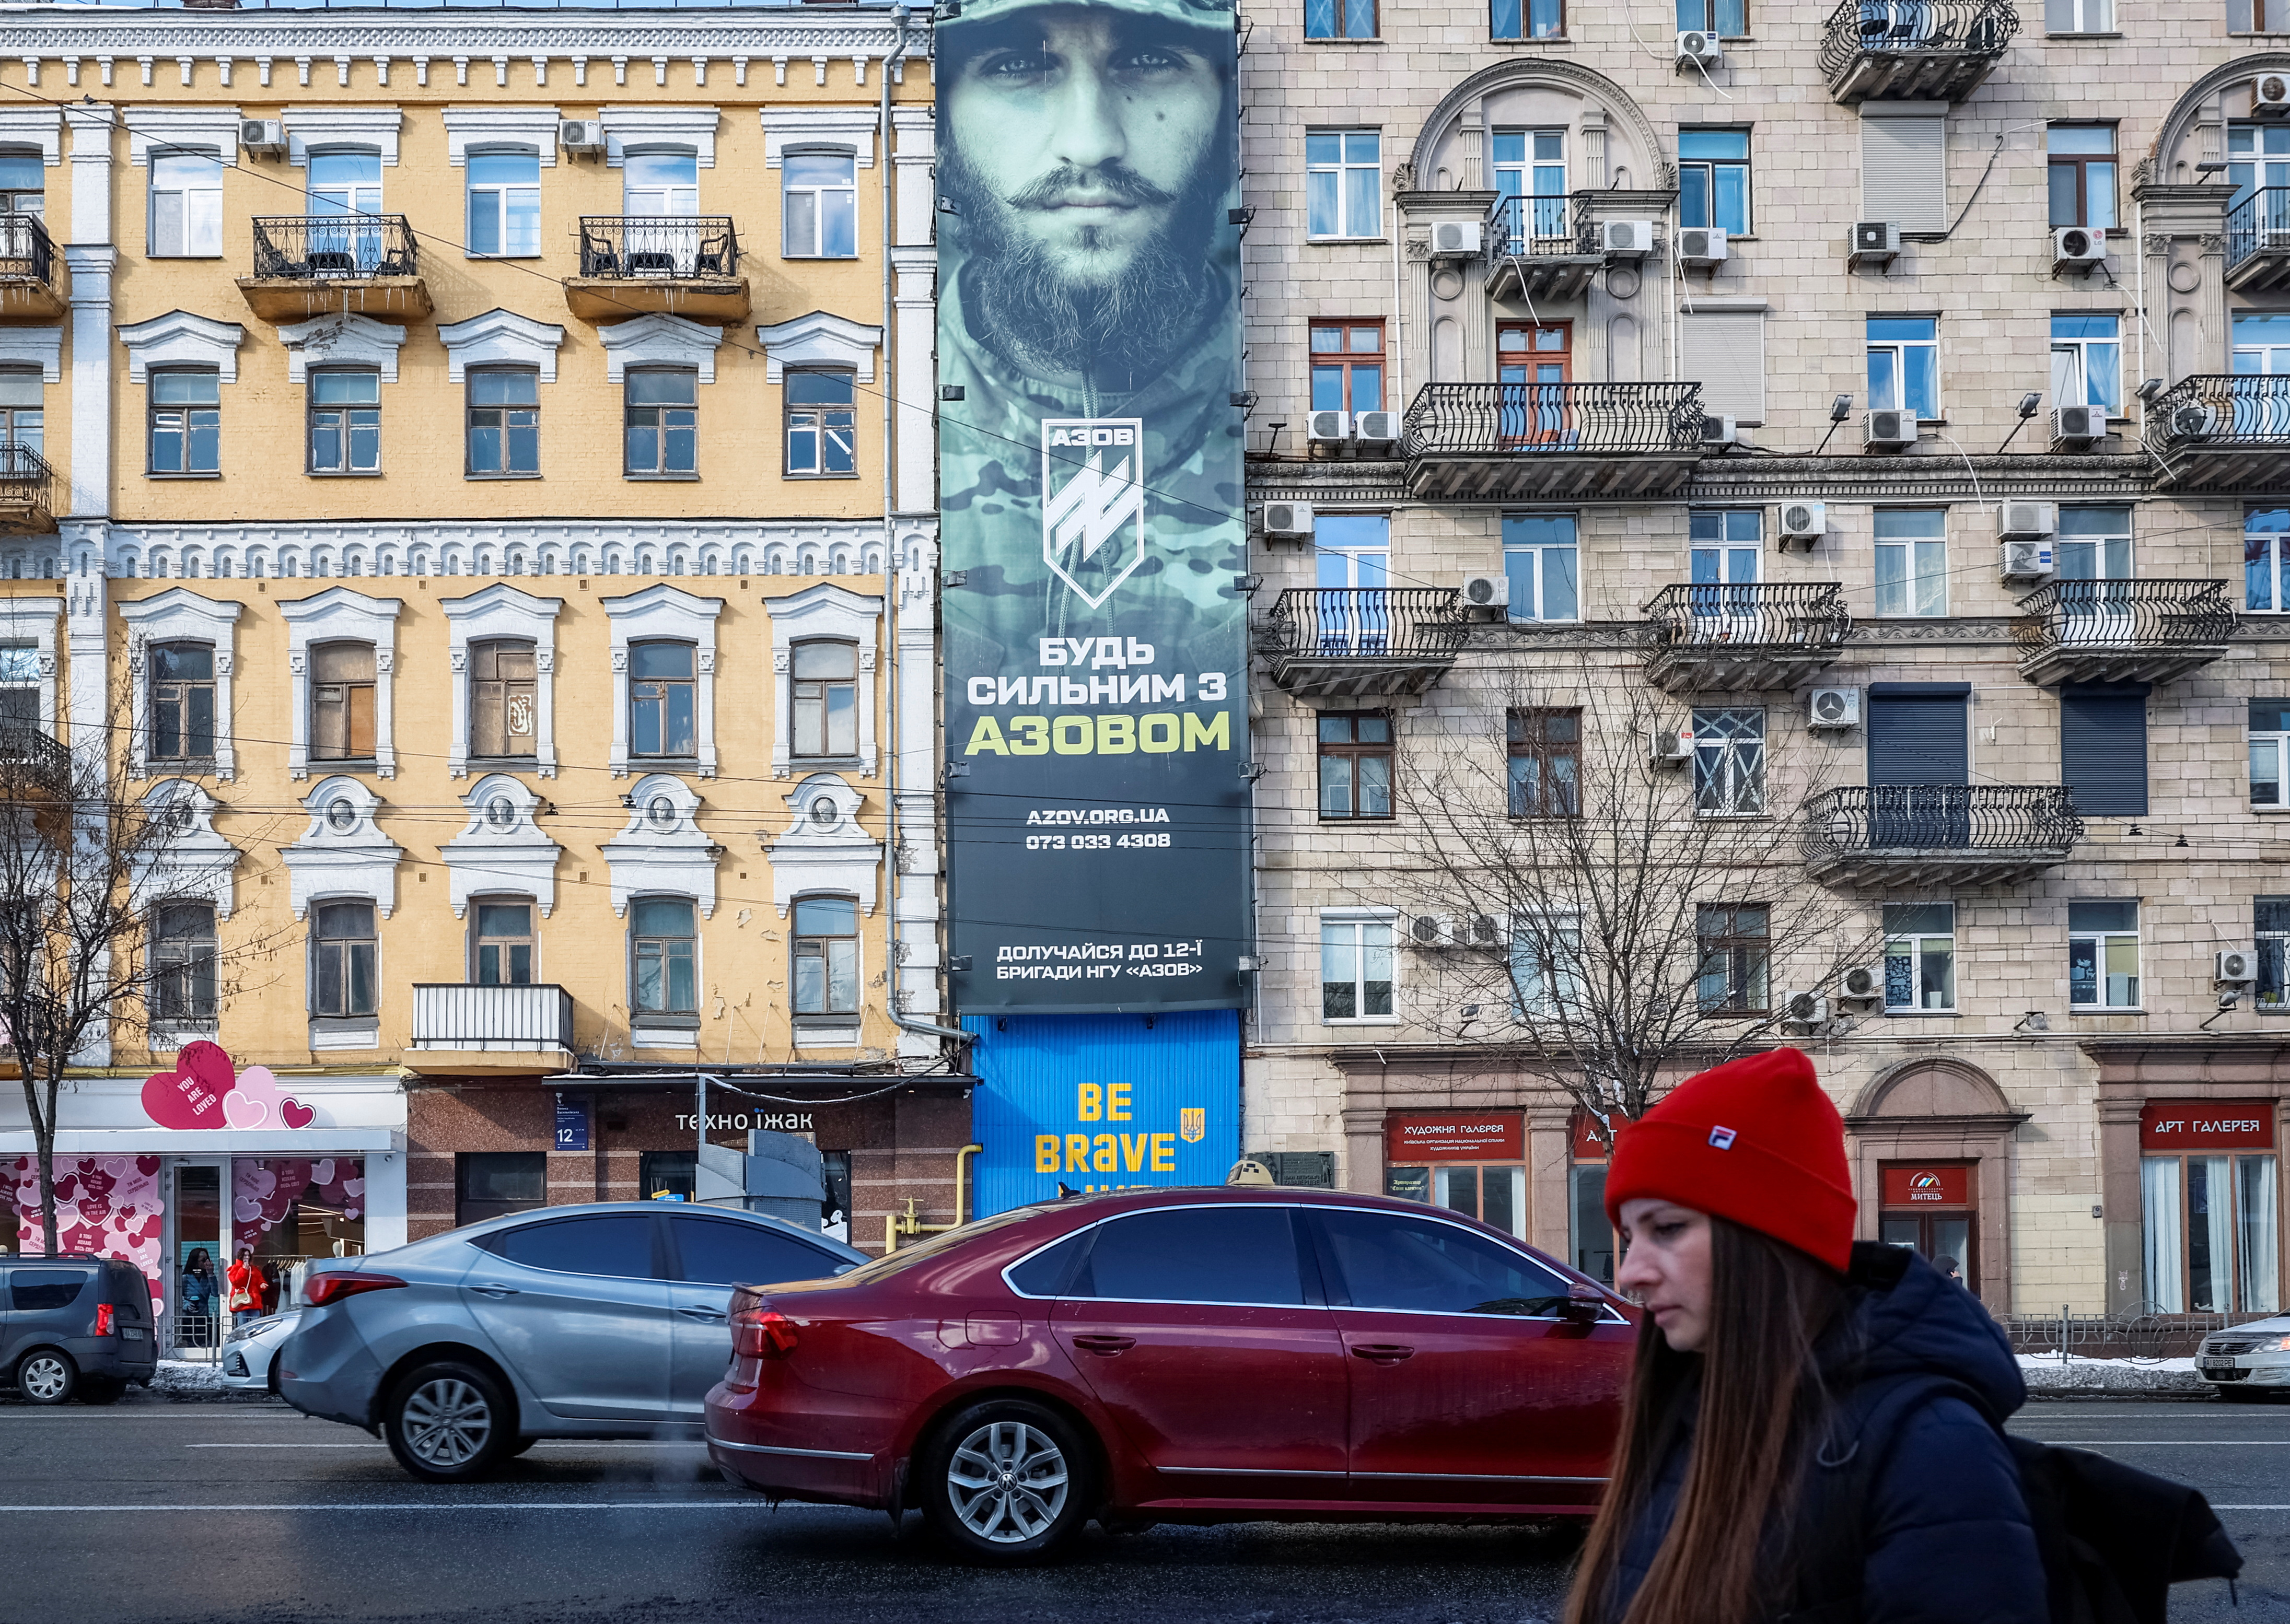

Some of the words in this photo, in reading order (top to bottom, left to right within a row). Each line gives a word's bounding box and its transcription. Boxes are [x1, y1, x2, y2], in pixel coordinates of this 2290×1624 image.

[1051, 428, 1134, 447] АЗОВ
[1039, 636, 1154, 669] БУДЬ
[967, 673, 1185, 705] СИЛЬНИМ
[1199, 672, 1227, 702] З
[964, 711, 1230, 756] АЗОВОМ
[1027, 808, 1170, 825] AZOV.ORG.UA
[1026, 835, 1065, 850] 073
[1071, 834, 1111, 849] 033
[1117, 833, 1171, 848] 4308
[997, 942, 1124, 962] ДОЛУЧАЙСЯ
[1129, 943, 1158, 961] ДО
[1164, 939, 1203, 957] 12-Ї
[996, 965, 1082, 980] БРИГАДИ
[1087, 964, 1121, 979] НГУ
[177, 1076, 194, 1092] YOU
[187, 1086, 204, 1103] ARE
[1078, 1083, 1132, 1121] BE
[192, 1094, 217, 1116] LOVED
[675, 1113, 748, 1130] техно
[753, 1107, 813, 1130] їжак
[2155, 1120, 2185, 1134] АРТ
[2192, 1119, 2260, 1133] ГАЛЕРЕЯ
[557, 1128, 573, 1142] 12
[1404, 1125, 1456, 1135] ХУДОЖНЯ
[1586, 1129, 1618, 1142] АТ
